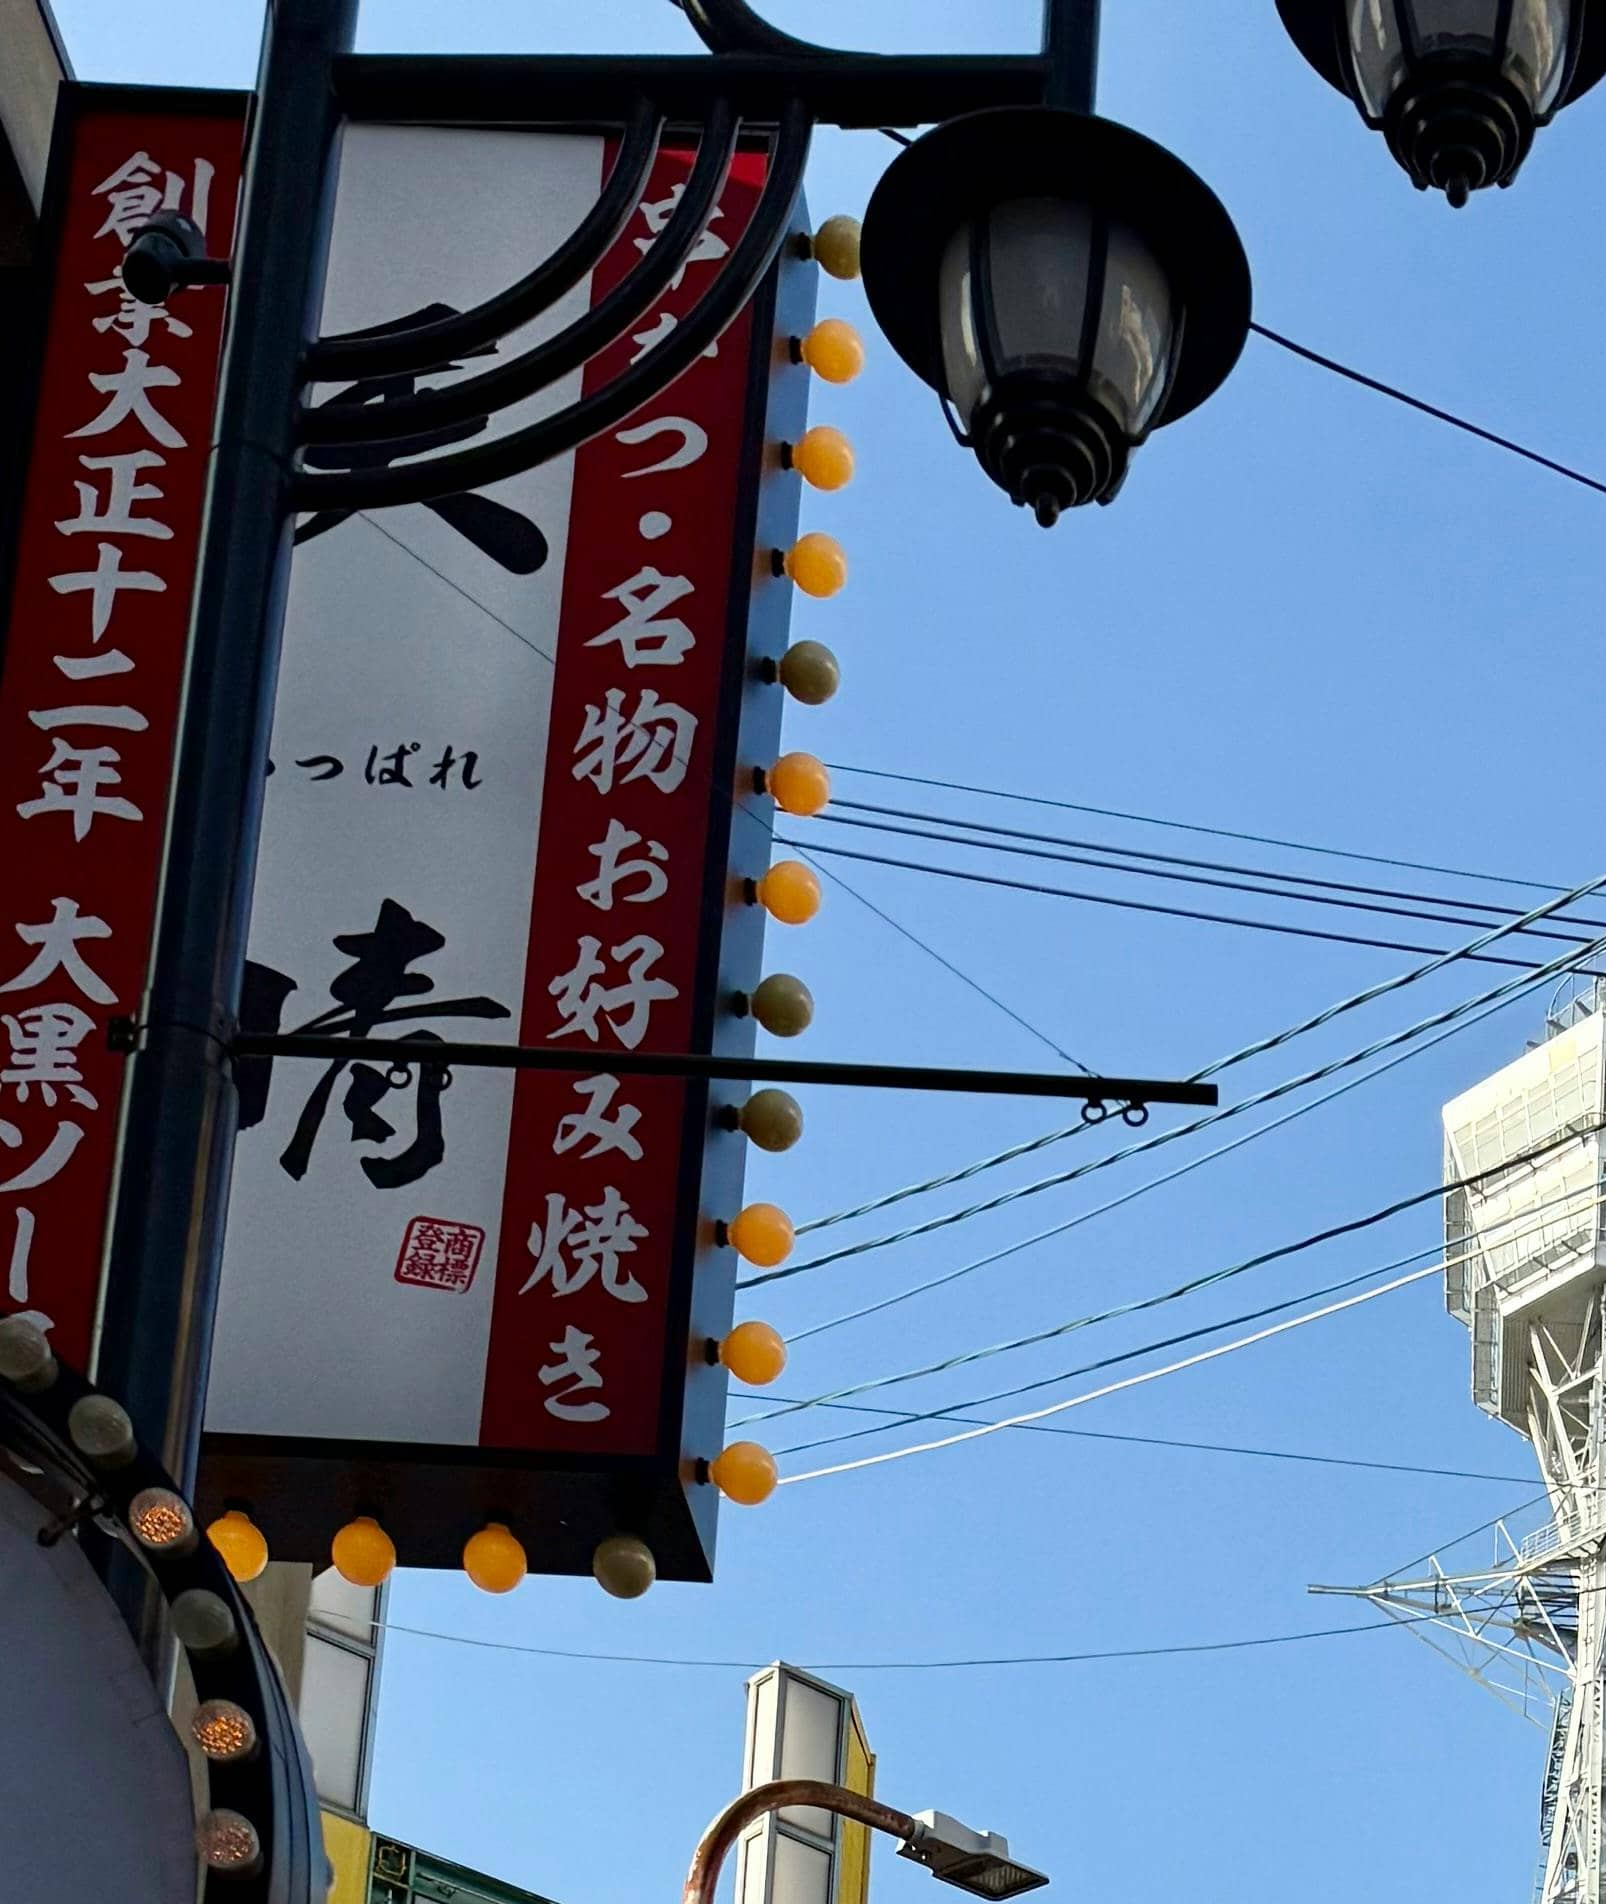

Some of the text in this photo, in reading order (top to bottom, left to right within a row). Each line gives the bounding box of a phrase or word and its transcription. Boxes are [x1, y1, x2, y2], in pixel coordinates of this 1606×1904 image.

[264, 743, 483, 791] っぱれ
[0, 898, 118, 1354] 大黒ソー
